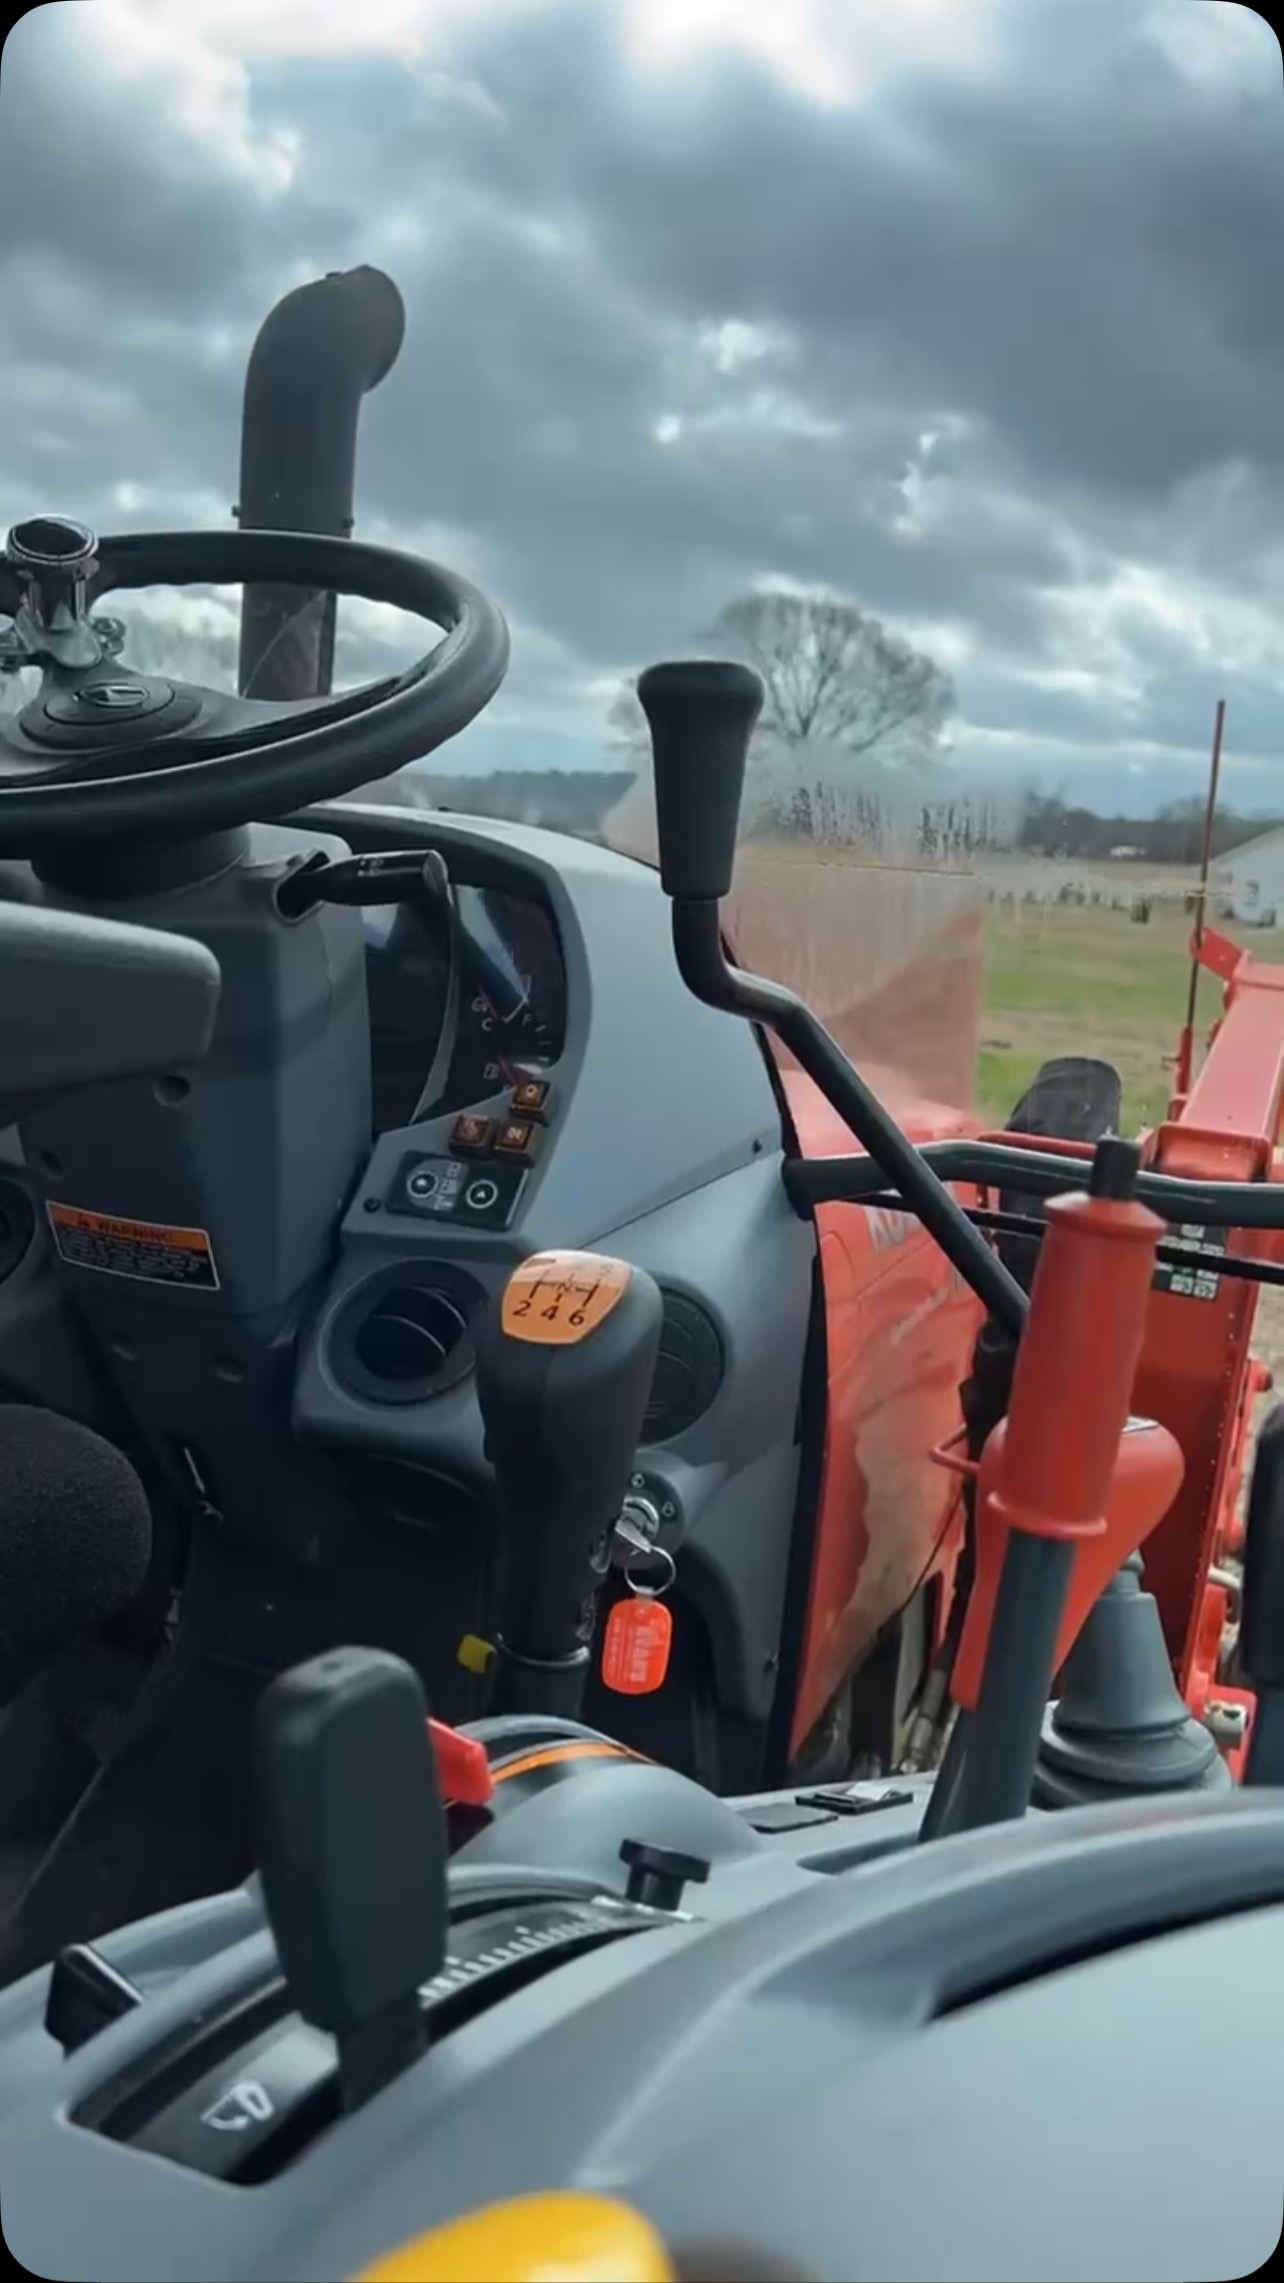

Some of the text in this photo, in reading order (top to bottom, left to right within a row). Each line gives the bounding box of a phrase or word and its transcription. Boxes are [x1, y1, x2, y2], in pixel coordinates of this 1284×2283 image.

[97, 1218, 171, 1245] WARNING
[512, 1300, 586, 1327] 2 4 6
